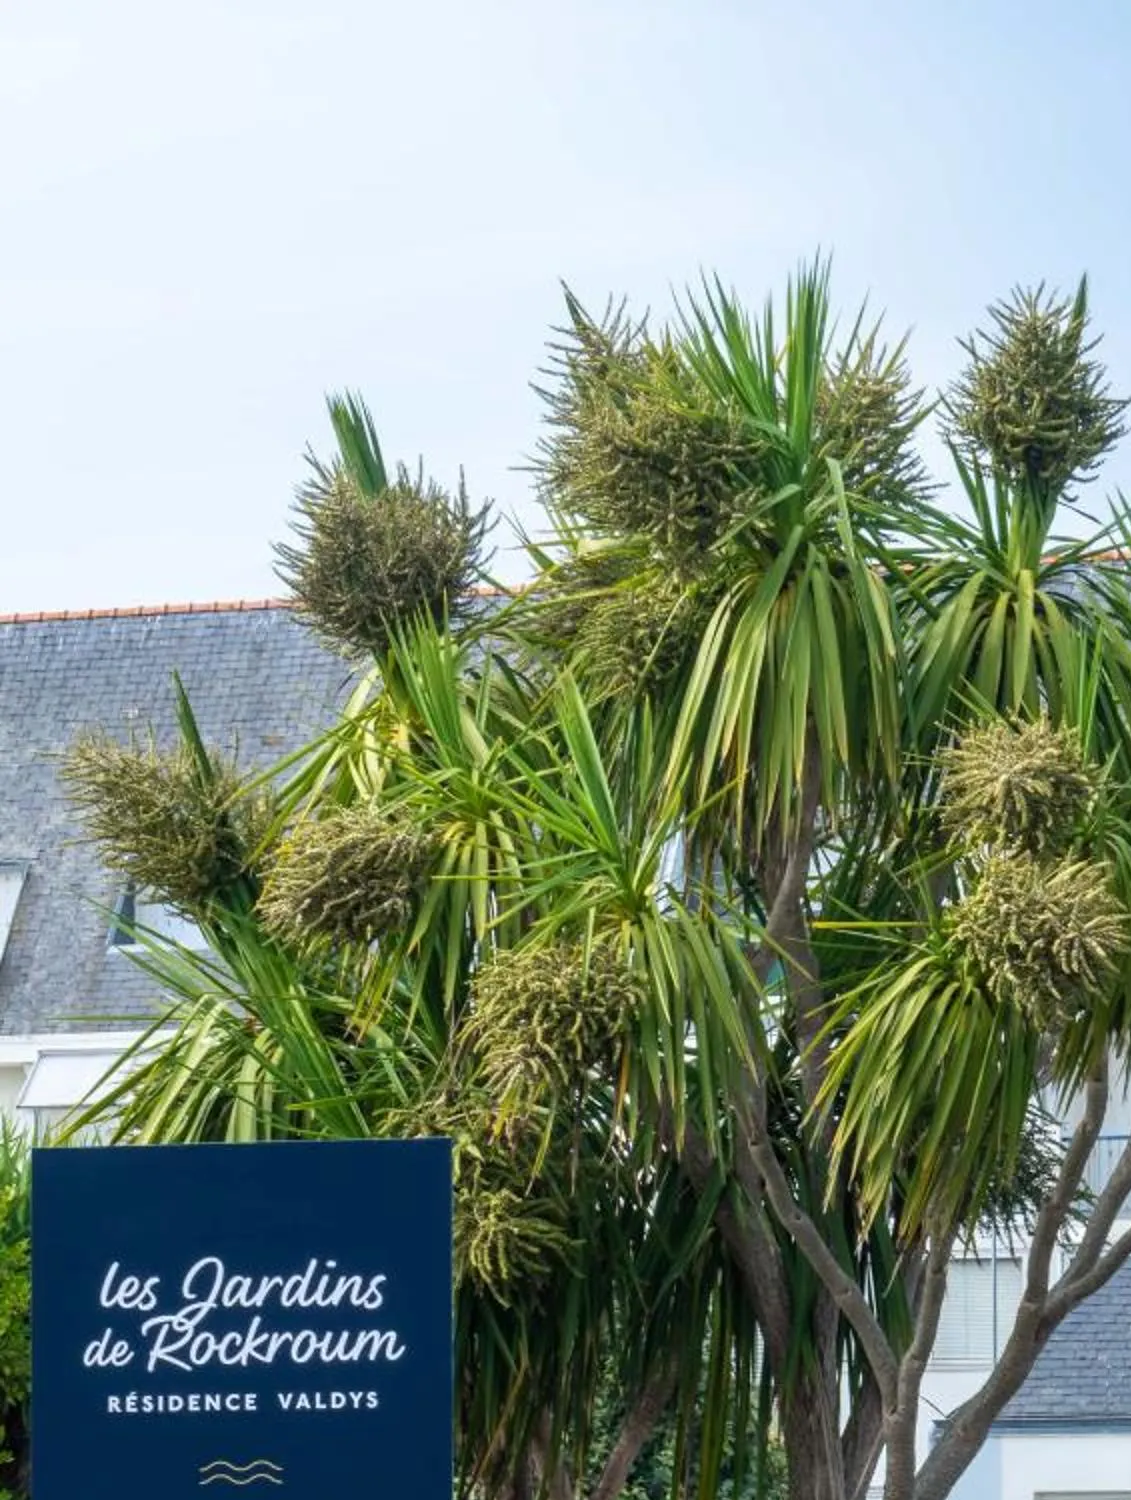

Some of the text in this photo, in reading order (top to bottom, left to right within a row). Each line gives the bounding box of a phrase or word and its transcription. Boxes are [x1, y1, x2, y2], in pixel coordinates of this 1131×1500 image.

[99, 1256, 387, 1331] les Jardins
[83, 1315, 405, 1372] de Rockroum
[107, 1391, 379, 1413] RÉSIDENCE VALDYS
